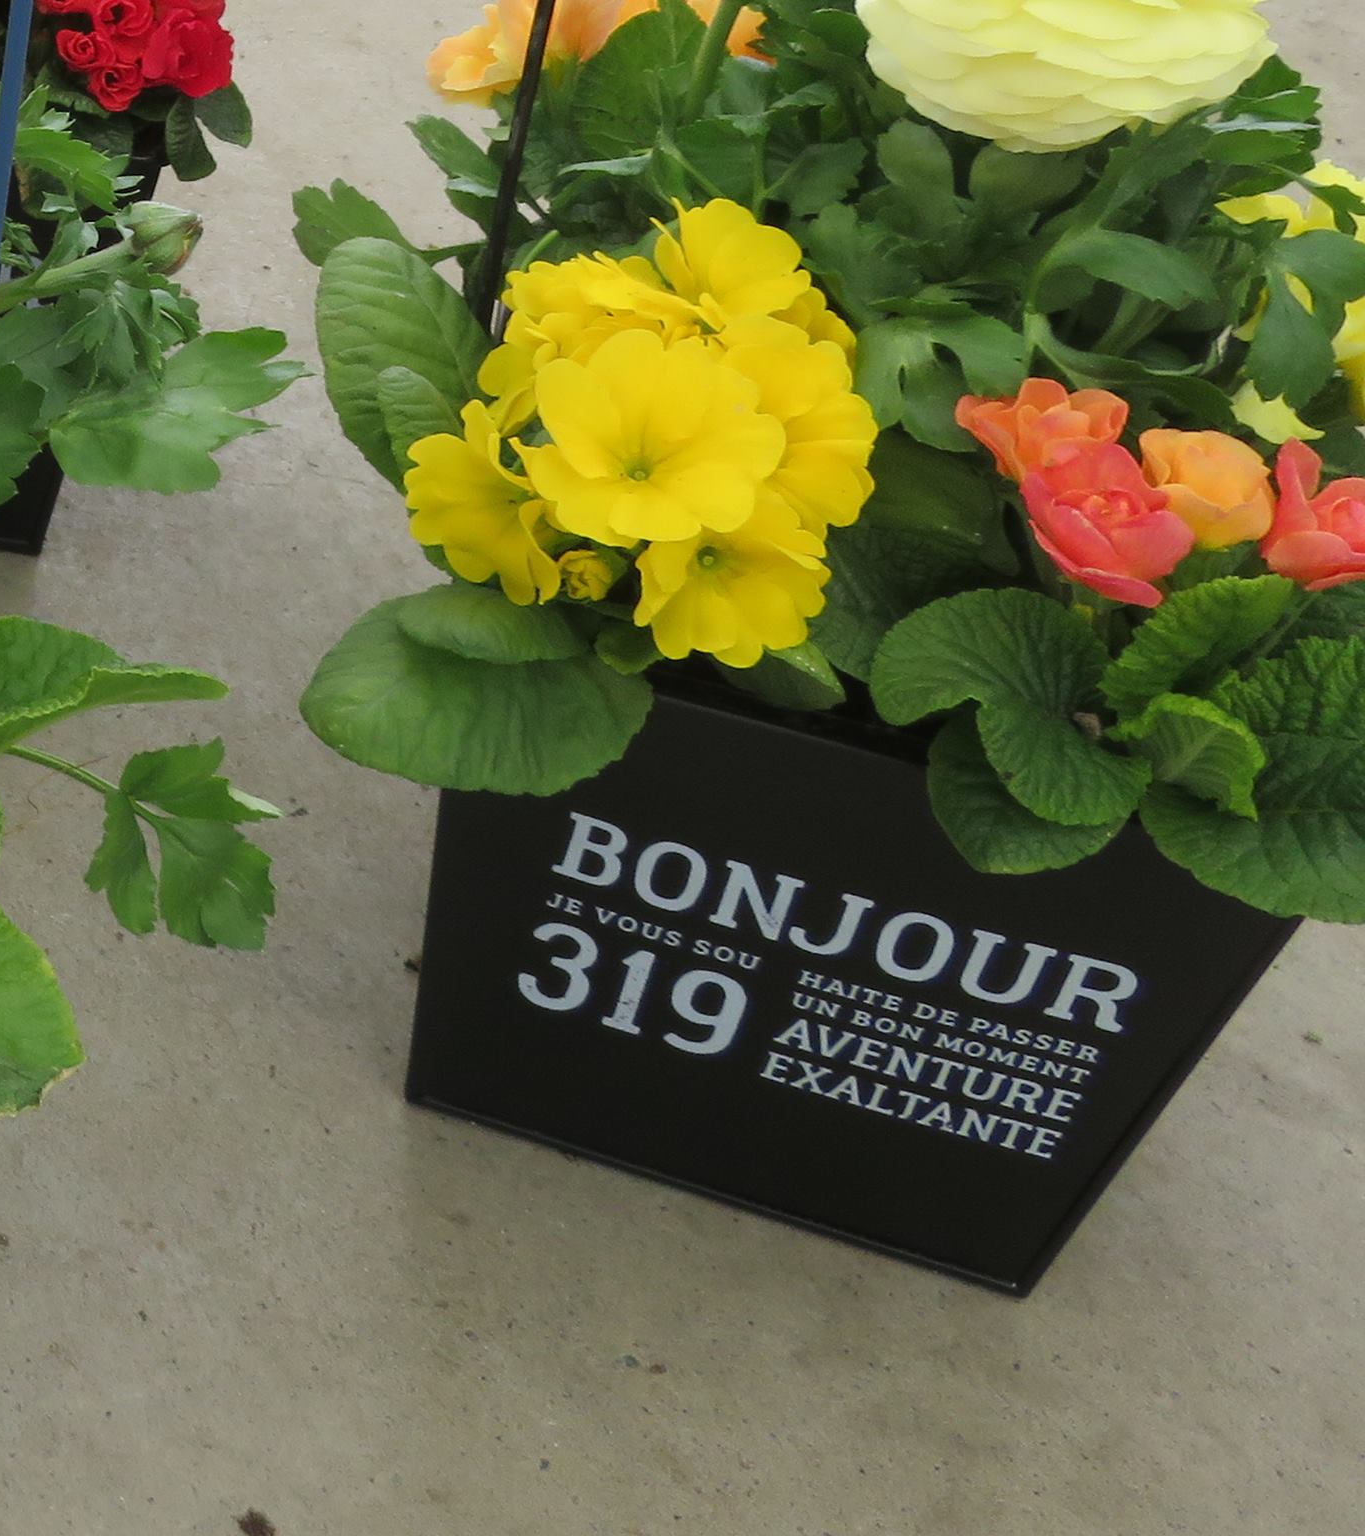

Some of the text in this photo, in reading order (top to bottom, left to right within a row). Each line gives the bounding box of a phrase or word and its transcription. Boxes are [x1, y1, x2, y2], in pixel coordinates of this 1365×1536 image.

[545, 892, 761, 971] JE VOUS SOU
[552, 812, 1138, 1034] BONJOUR
[517, 922, 749, 1056] 319
[792, 990, 1090, 1087] UN BON MOMENT
[797, 968, 1099, 1064] HAITE DE PASSER
[759, 1051, 1063, 1159] EXALTANTE
[773, 1017, 1082, 1123] AVENTURE
